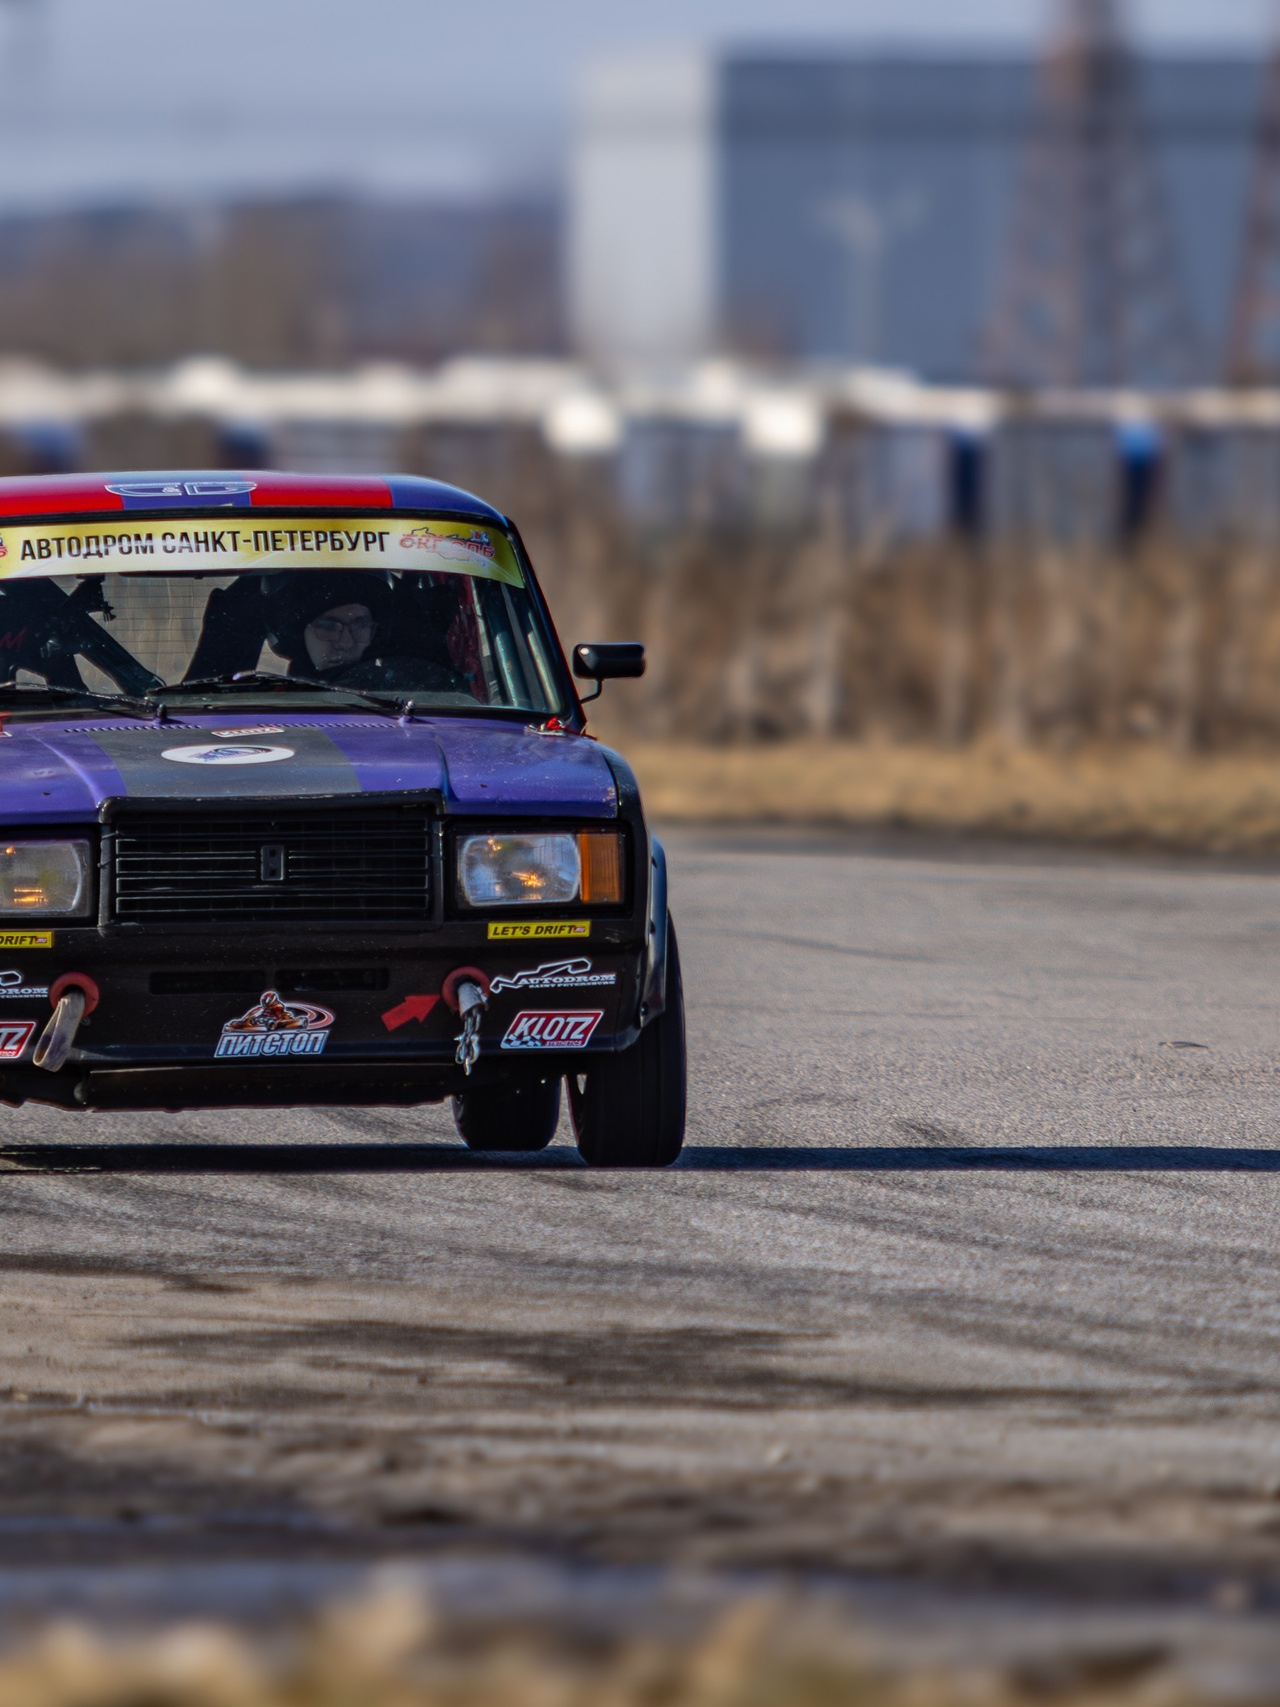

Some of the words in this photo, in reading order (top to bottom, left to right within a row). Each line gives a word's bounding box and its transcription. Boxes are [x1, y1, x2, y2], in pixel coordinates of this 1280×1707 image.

[20, 532, 155, 561] АВТОДРОМ
[161, 530, 390, 554] САНКТ-ПЕТЕРБУРГ
[493, 925, 532, 936] LET'S
[518, 974, 616, 986] AUTODROM
[513, 1016, 595, 1041] KLOTZ
[216, 1032, 328, 1056] ПИТСТОП
